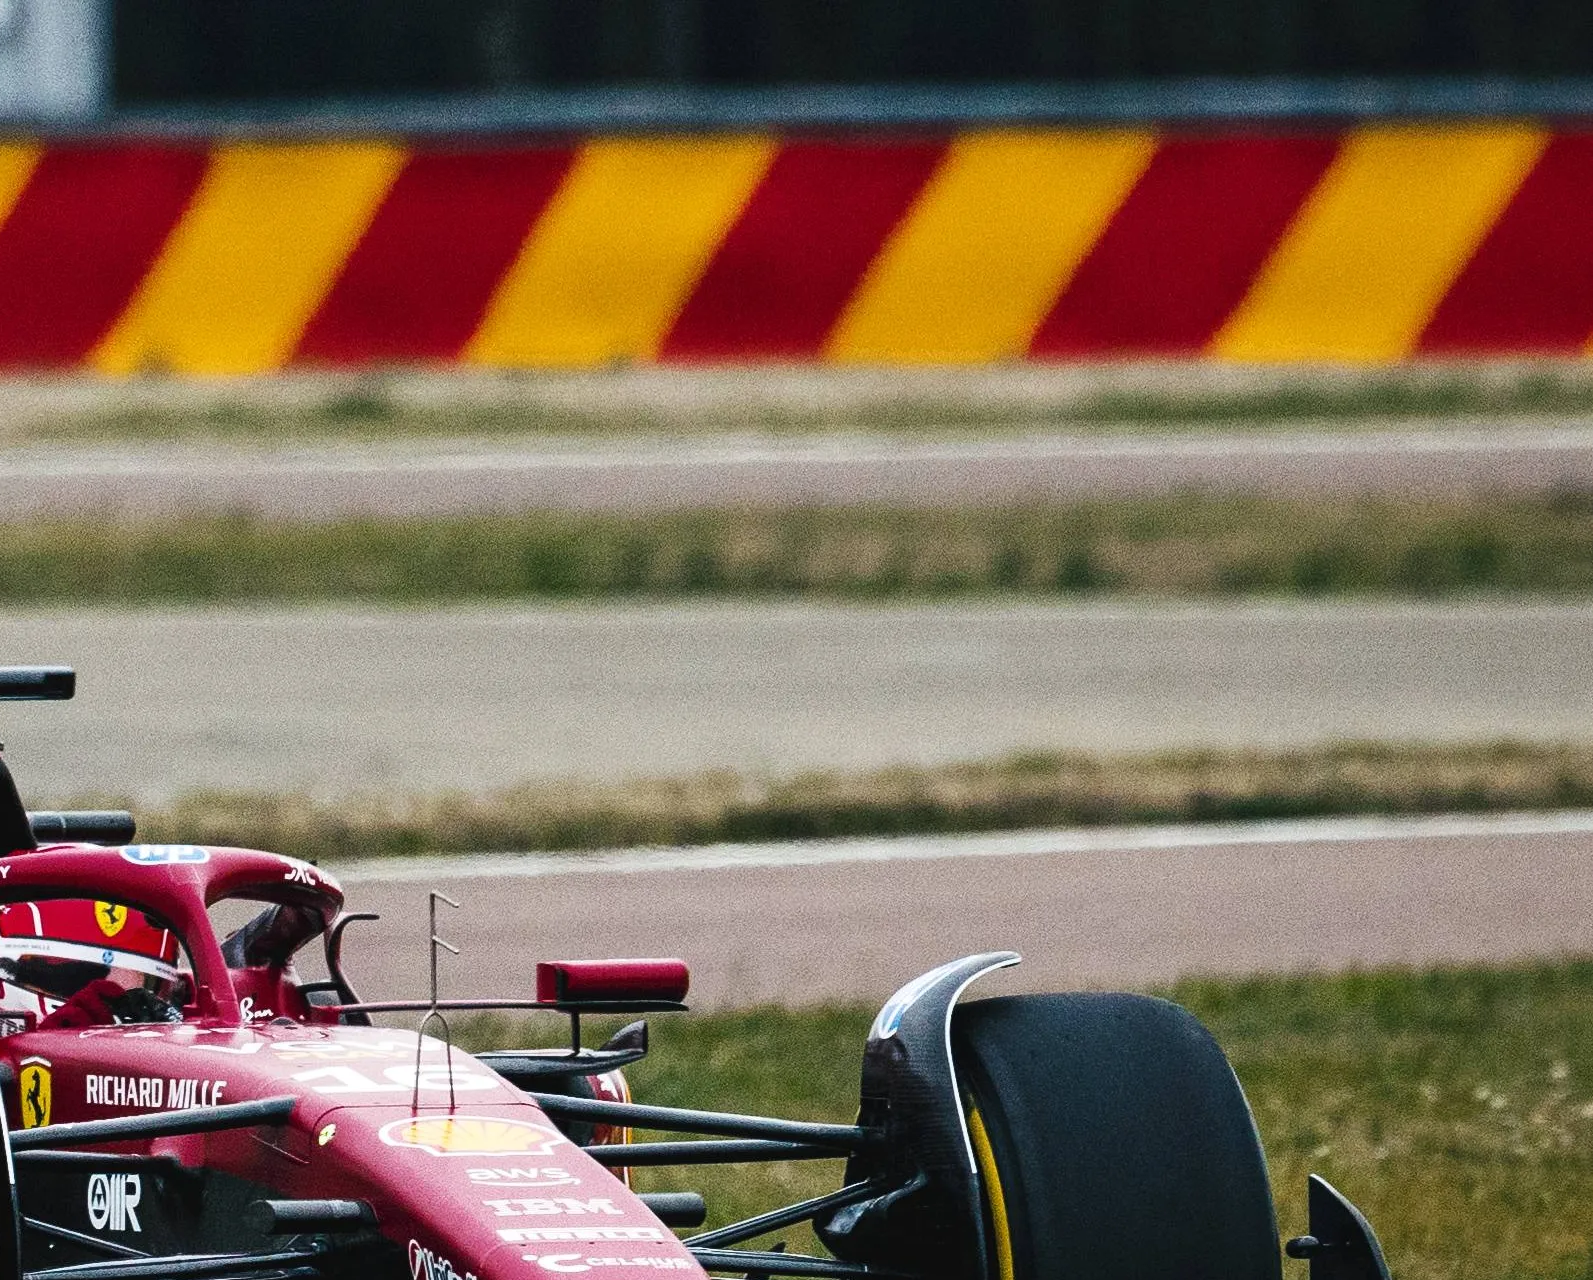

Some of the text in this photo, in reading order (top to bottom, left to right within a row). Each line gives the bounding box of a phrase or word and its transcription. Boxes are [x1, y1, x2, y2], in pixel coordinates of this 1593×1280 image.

[86, 1074, 164, 1108] RICHARD
[291, 1064, 502, 1095] 16
[466, 1167, 572, 1180] aws
[482, 1198, 625, 1217] IBM
